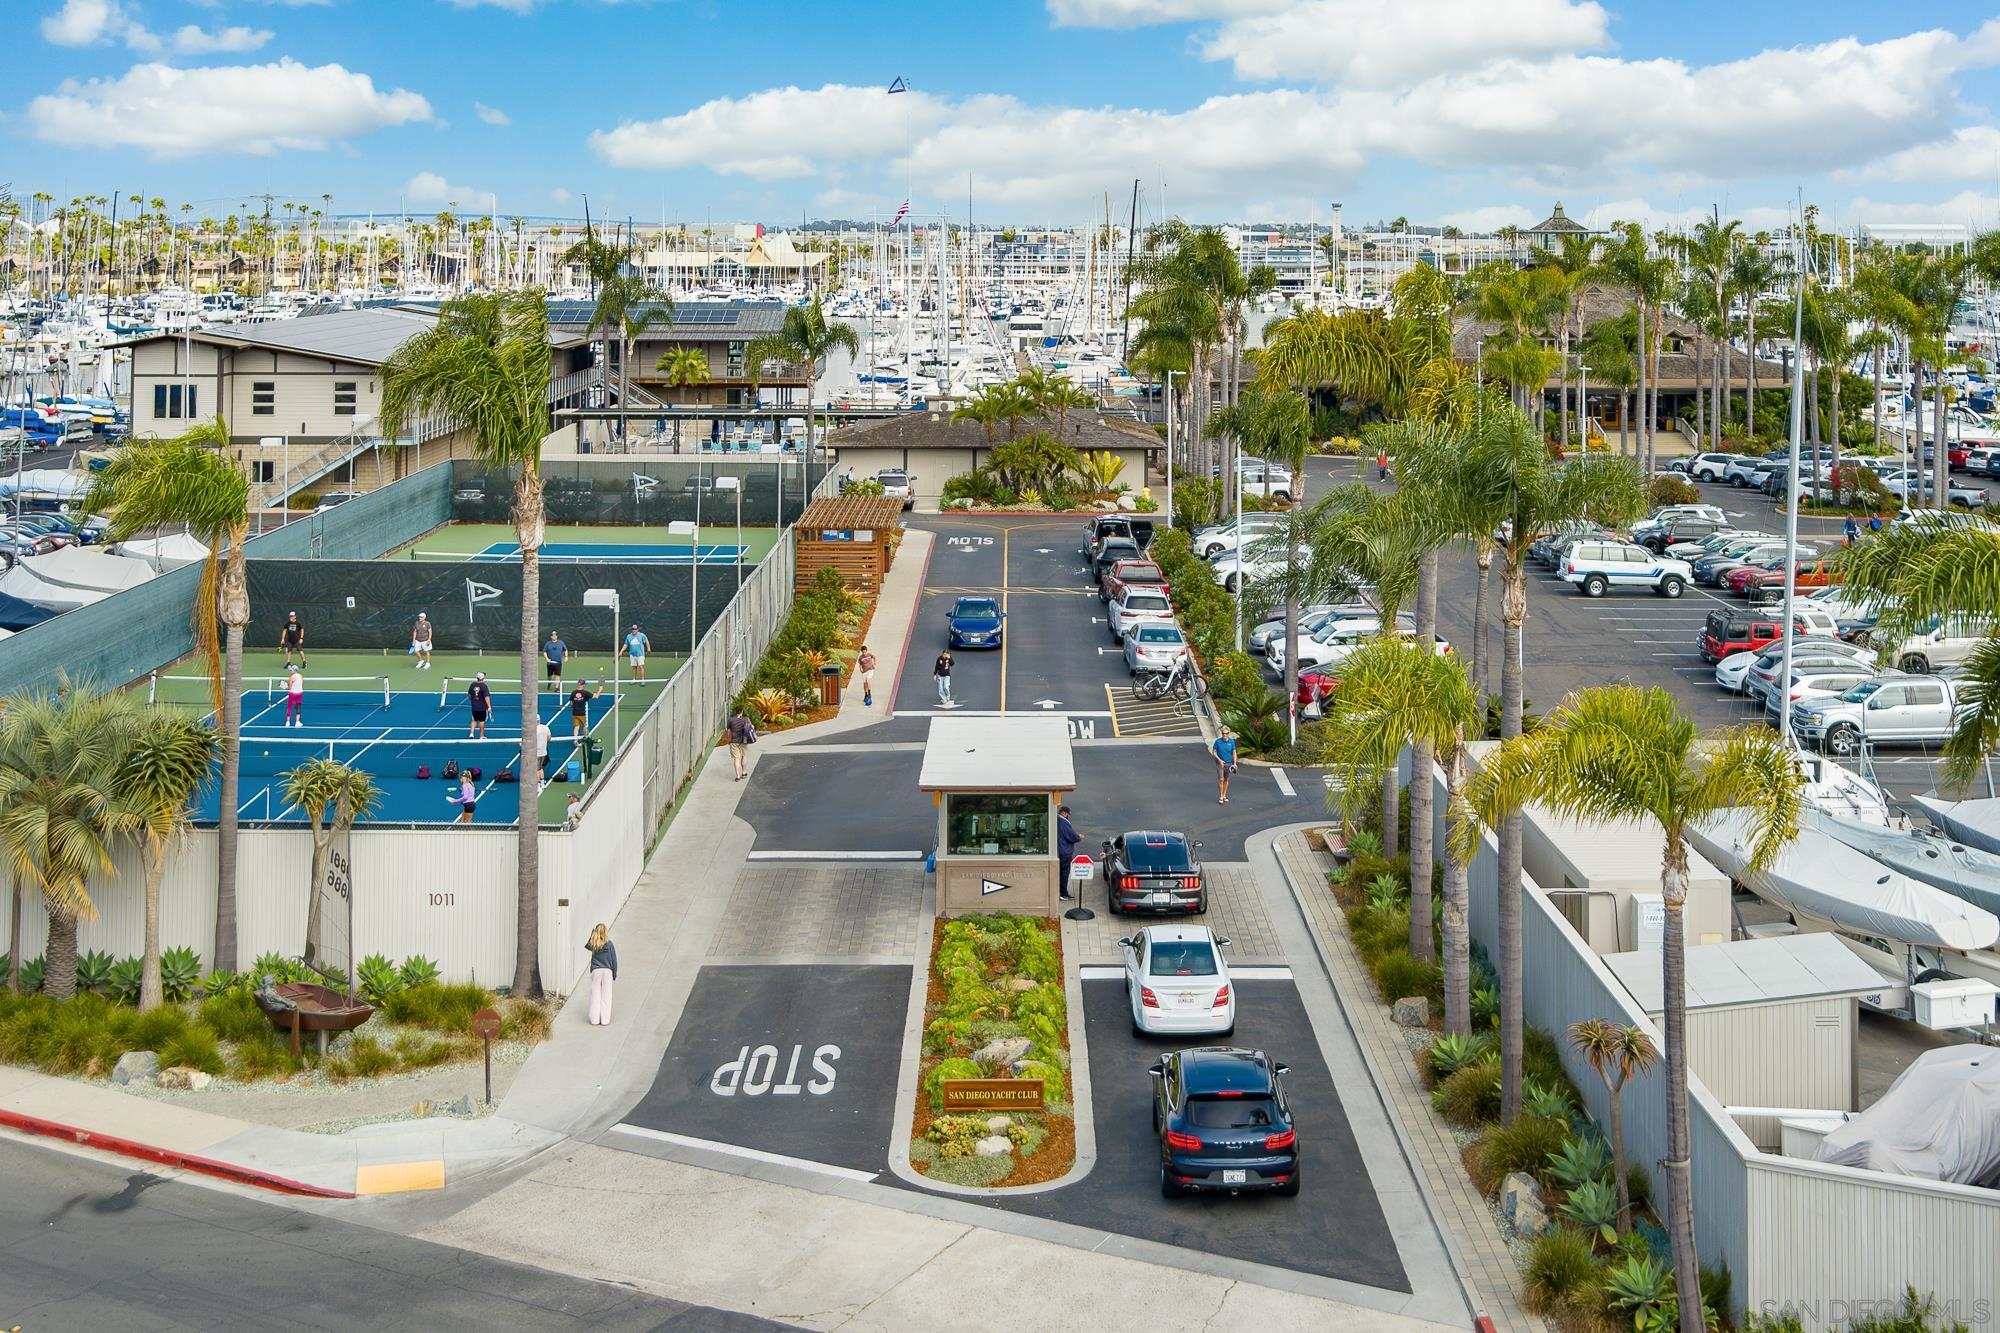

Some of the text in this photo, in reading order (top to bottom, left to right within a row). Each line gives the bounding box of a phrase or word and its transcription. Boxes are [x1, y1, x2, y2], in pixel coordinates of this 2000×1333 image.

[947, 536, 994, 545] SLOW
[1068, 719, 1095, 739] OW
[429, 893, 454, 906] 1011
[710, 1044, 842, 1096] STOP
[949, 1090, 1038, 1099] SAN DIEGO YACHT CLUB
